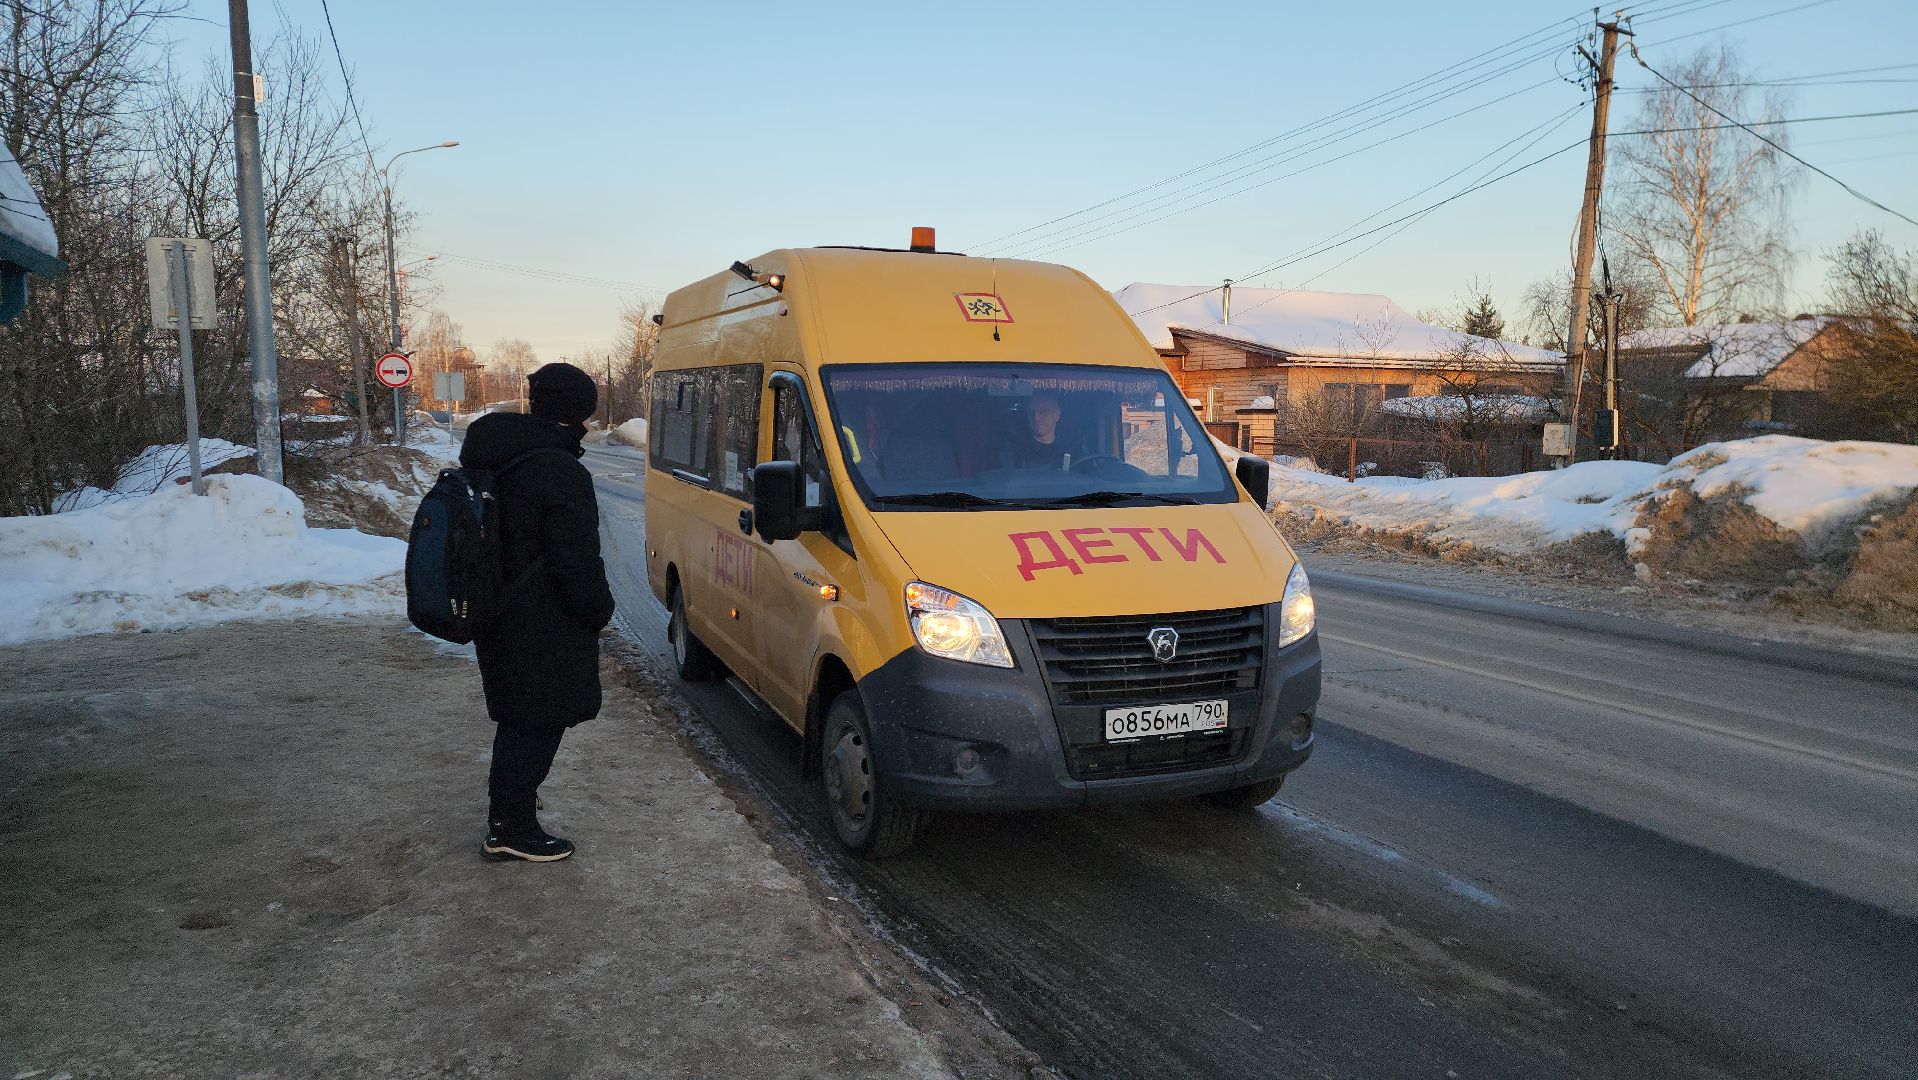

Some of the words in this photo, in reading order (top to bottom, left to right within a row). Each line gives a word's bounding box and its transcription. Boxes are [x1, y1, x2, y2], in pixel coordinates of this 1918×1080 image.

[715, 529, 753, 596] ДЕТИ
[1008, 527, 1228, 582] ДЕТИ
[1112, 710, 1190, 735] О856МА
[1194, 703, 1222, 721] 790
